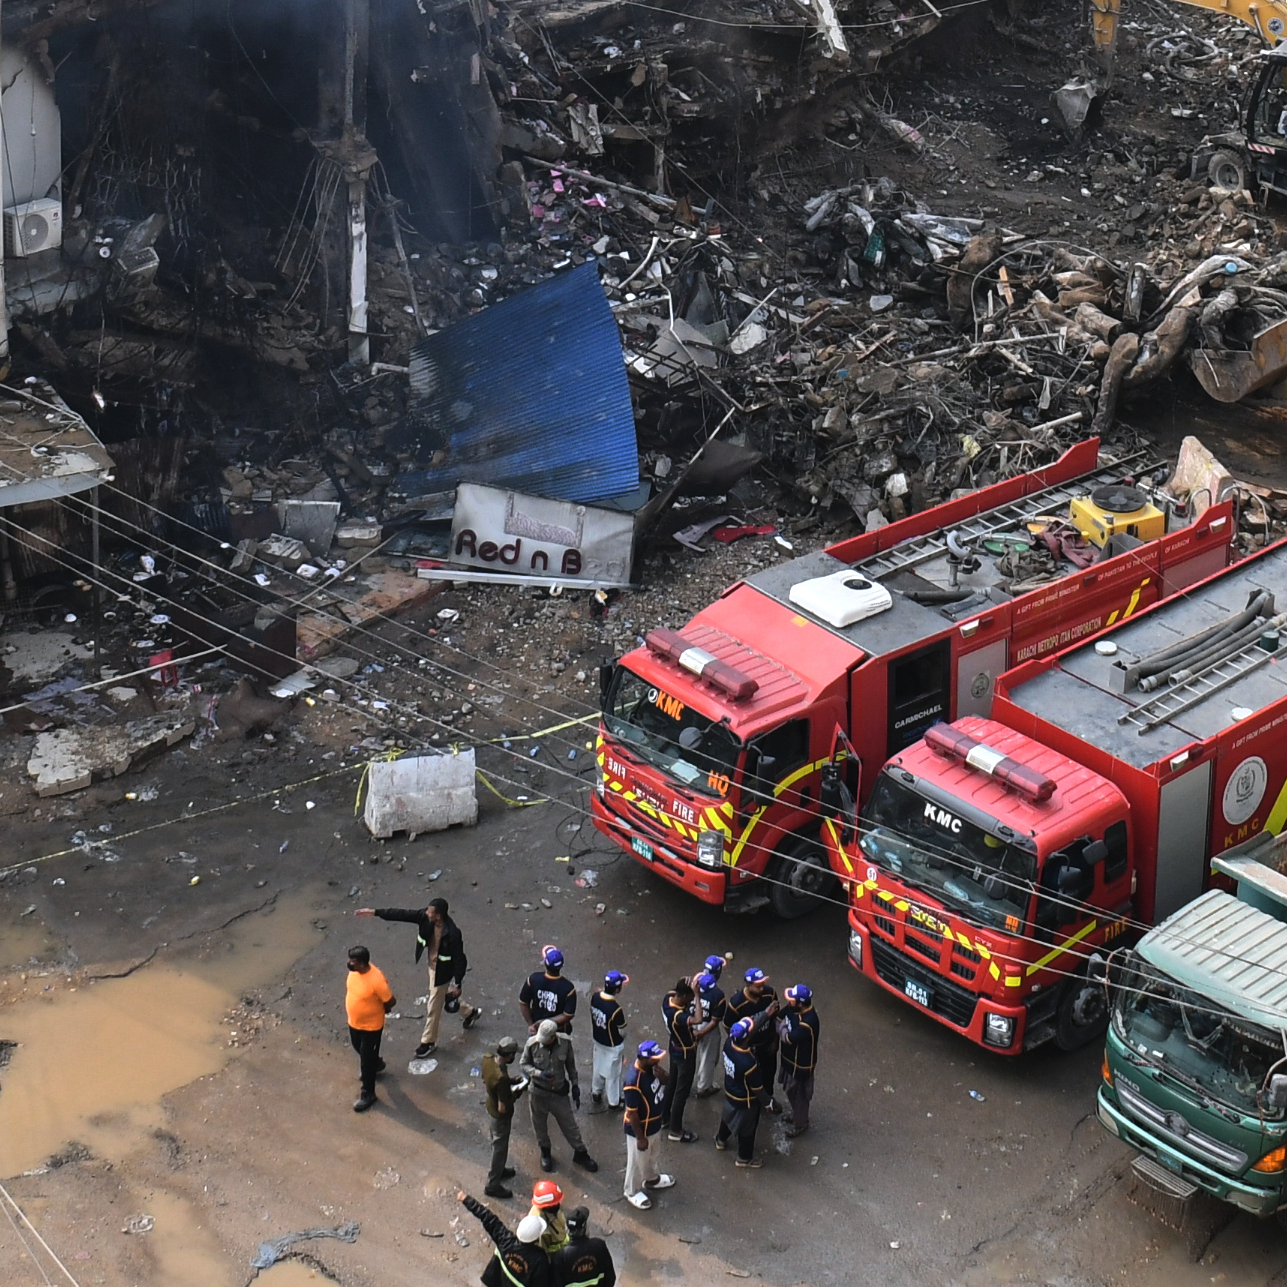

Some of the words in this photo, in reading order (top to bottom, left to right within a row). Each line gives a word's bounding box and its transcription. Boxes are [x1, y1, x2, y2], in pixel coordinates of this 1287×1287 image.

[455, 529, 521, 565] Red
[654, 691, 685, 721] KMC
[707, 770, 729, 796] HQ
[672, 799, 694, 822] FIRE
[924, 802, 962, 834] KMC
